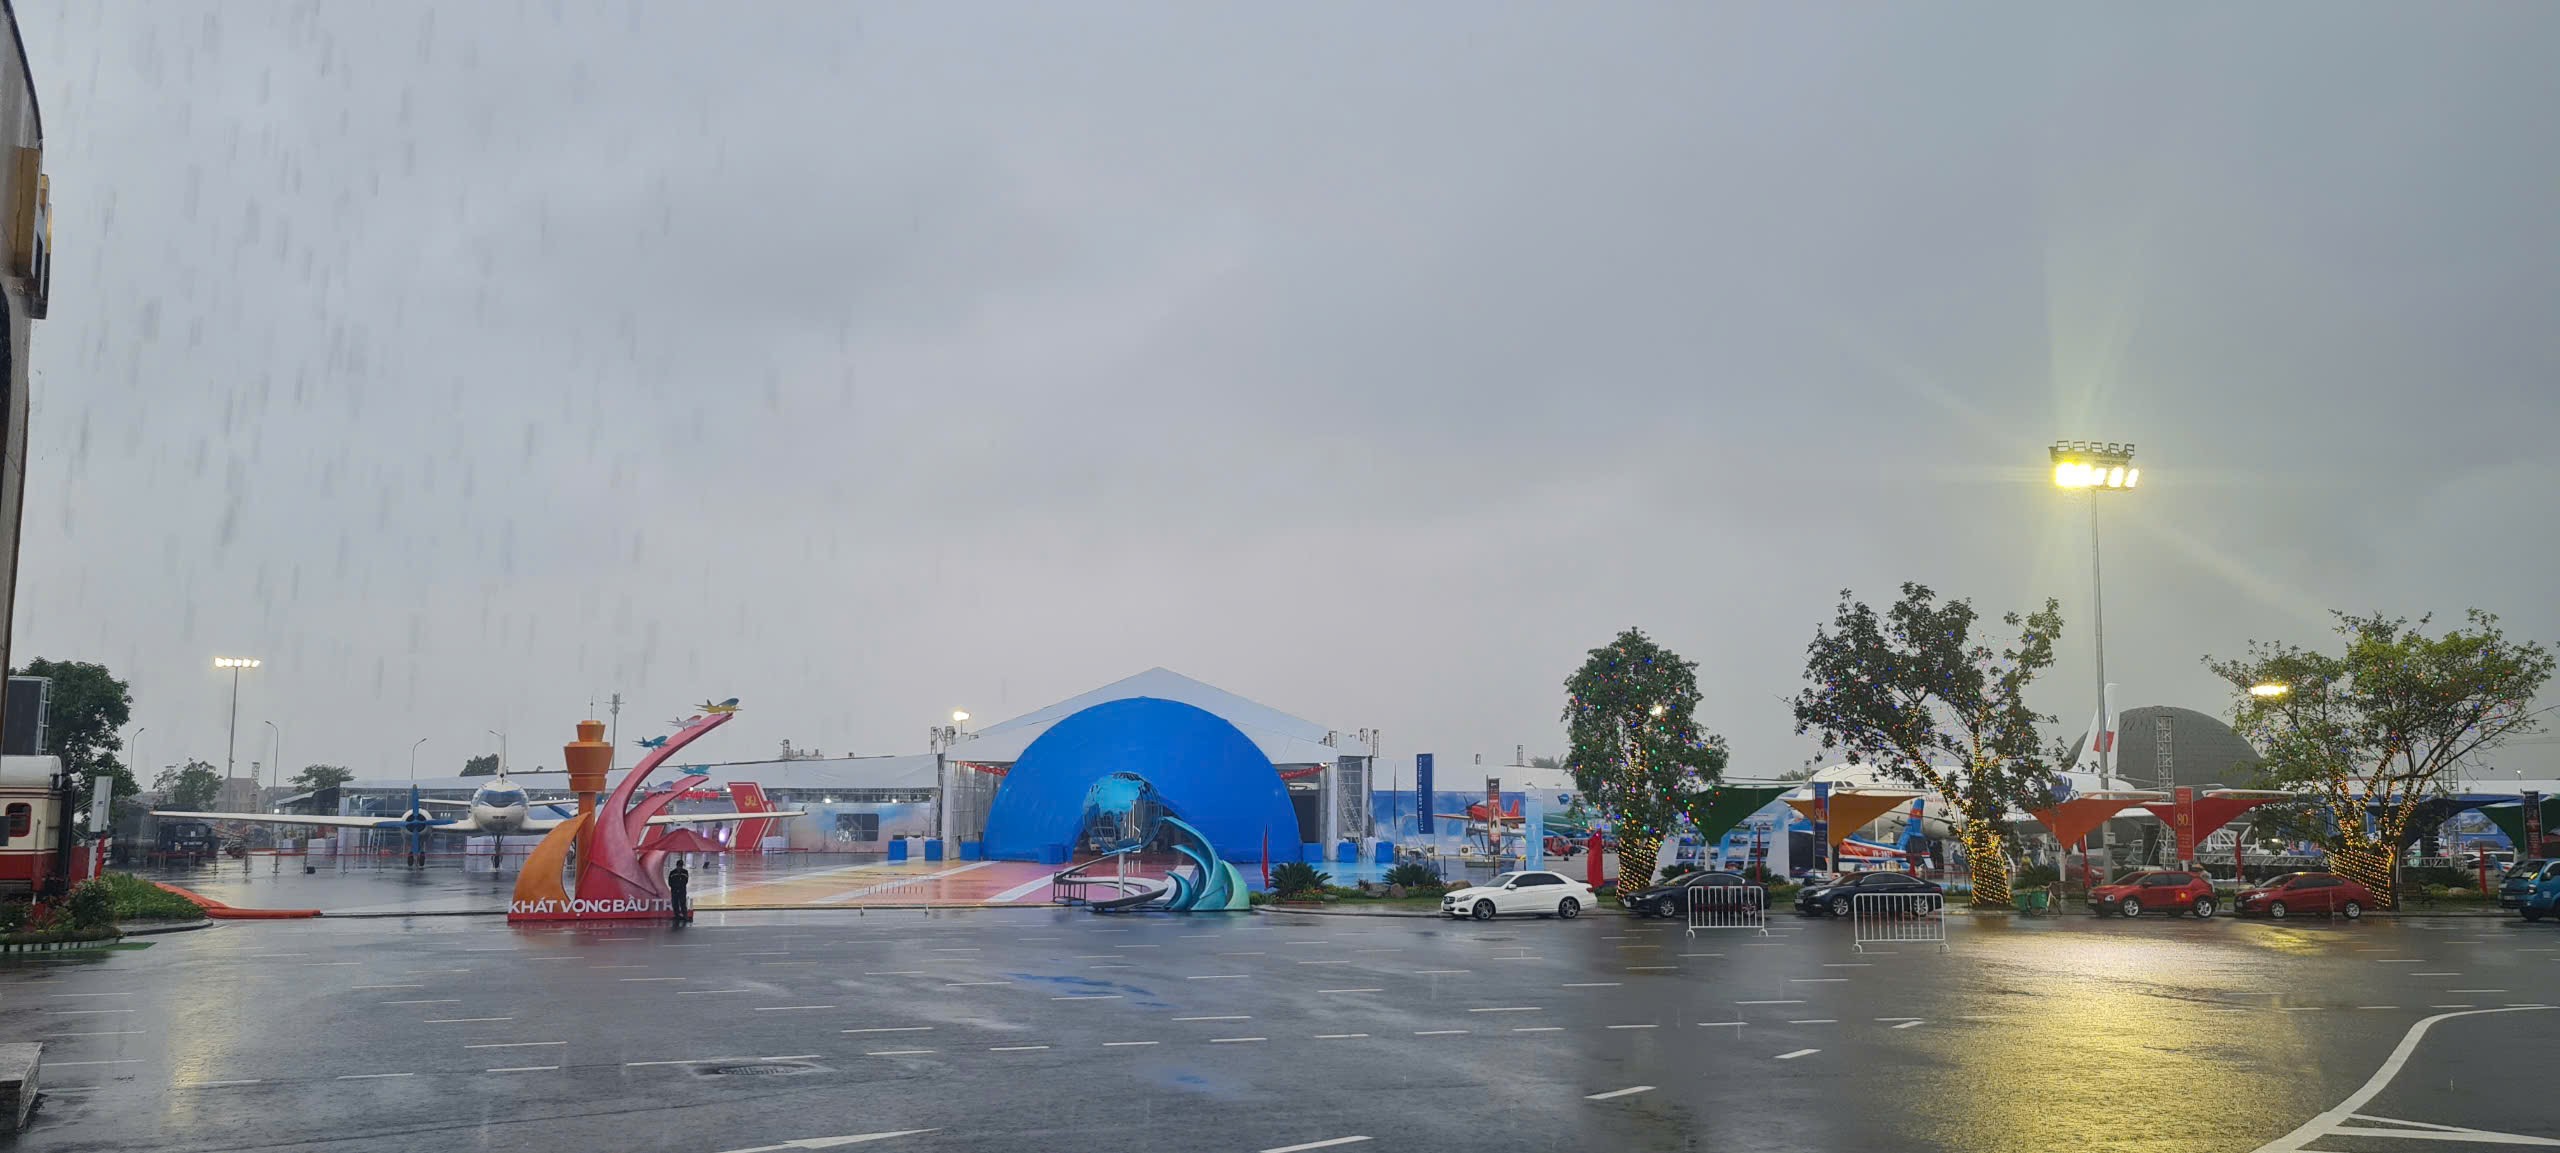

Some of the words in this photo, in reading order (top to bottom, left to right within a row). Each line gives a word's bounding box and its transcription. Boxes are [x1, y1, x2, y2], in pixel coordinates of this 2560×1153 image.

[2177, 813, 2188, 826] 80
[508, 897, 557, 913] KHÁT
[560, 899, 612, 917] VỌNG
[613, 894, 649, 912] BẦU
